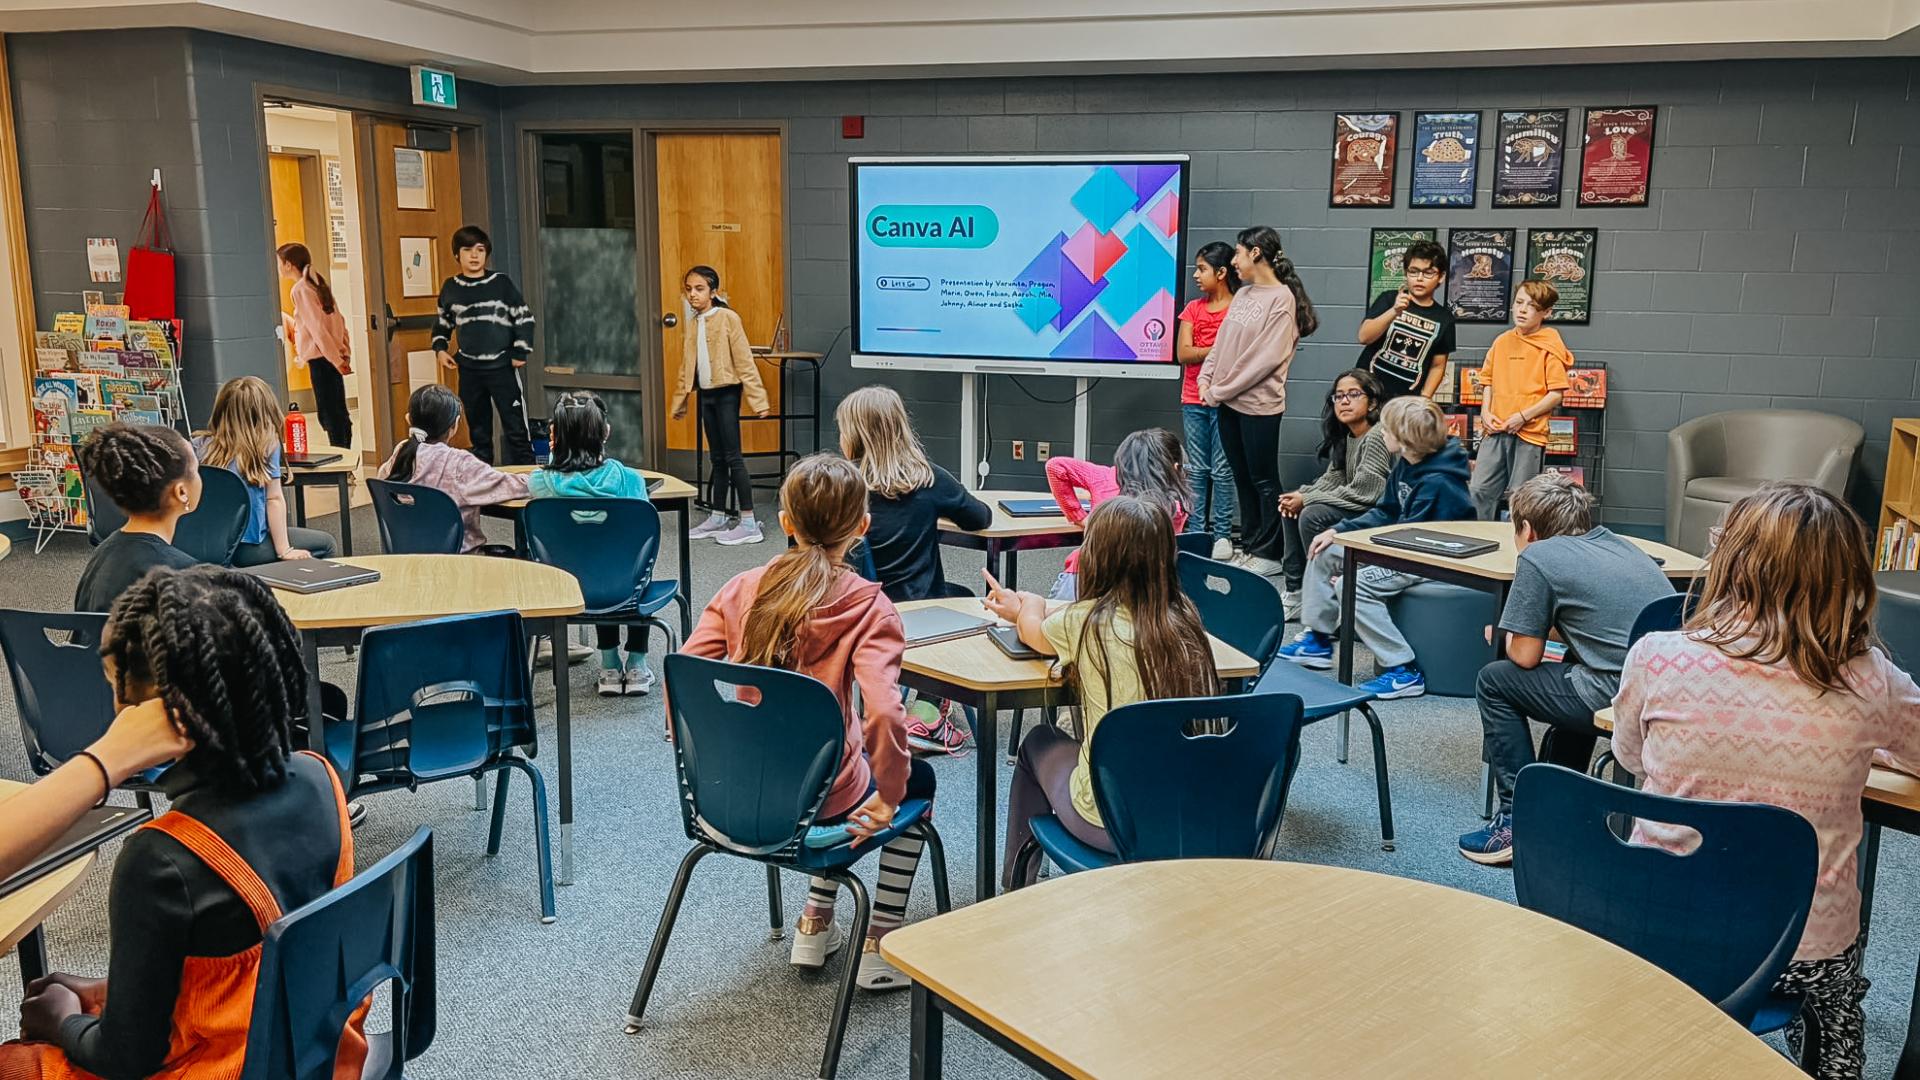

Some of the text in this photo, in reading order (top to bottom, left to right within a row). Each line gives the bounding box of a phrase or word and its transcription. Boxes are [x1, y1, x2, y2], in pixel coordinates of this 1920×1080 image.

[1432, 130, 1464, 139] Truth
[1604, 126, 1637, 135] Love
[1346, 132, 1387, 141] Courage
[1504, 128, 1560, 144] Humility
[871, 215, 974, 238] Canva AI
[1461, 247, 1505, 259] Honesty
[1541, 247, 1585, 259] Wisdom
[985, 280, 994, 289] by
[964, 290, 985, 298] Owen,
[940, 300, 966, 309] Johnny,
[1423, 322, 1435, 331] UP
[291, 423, 301, 453] CANADA
